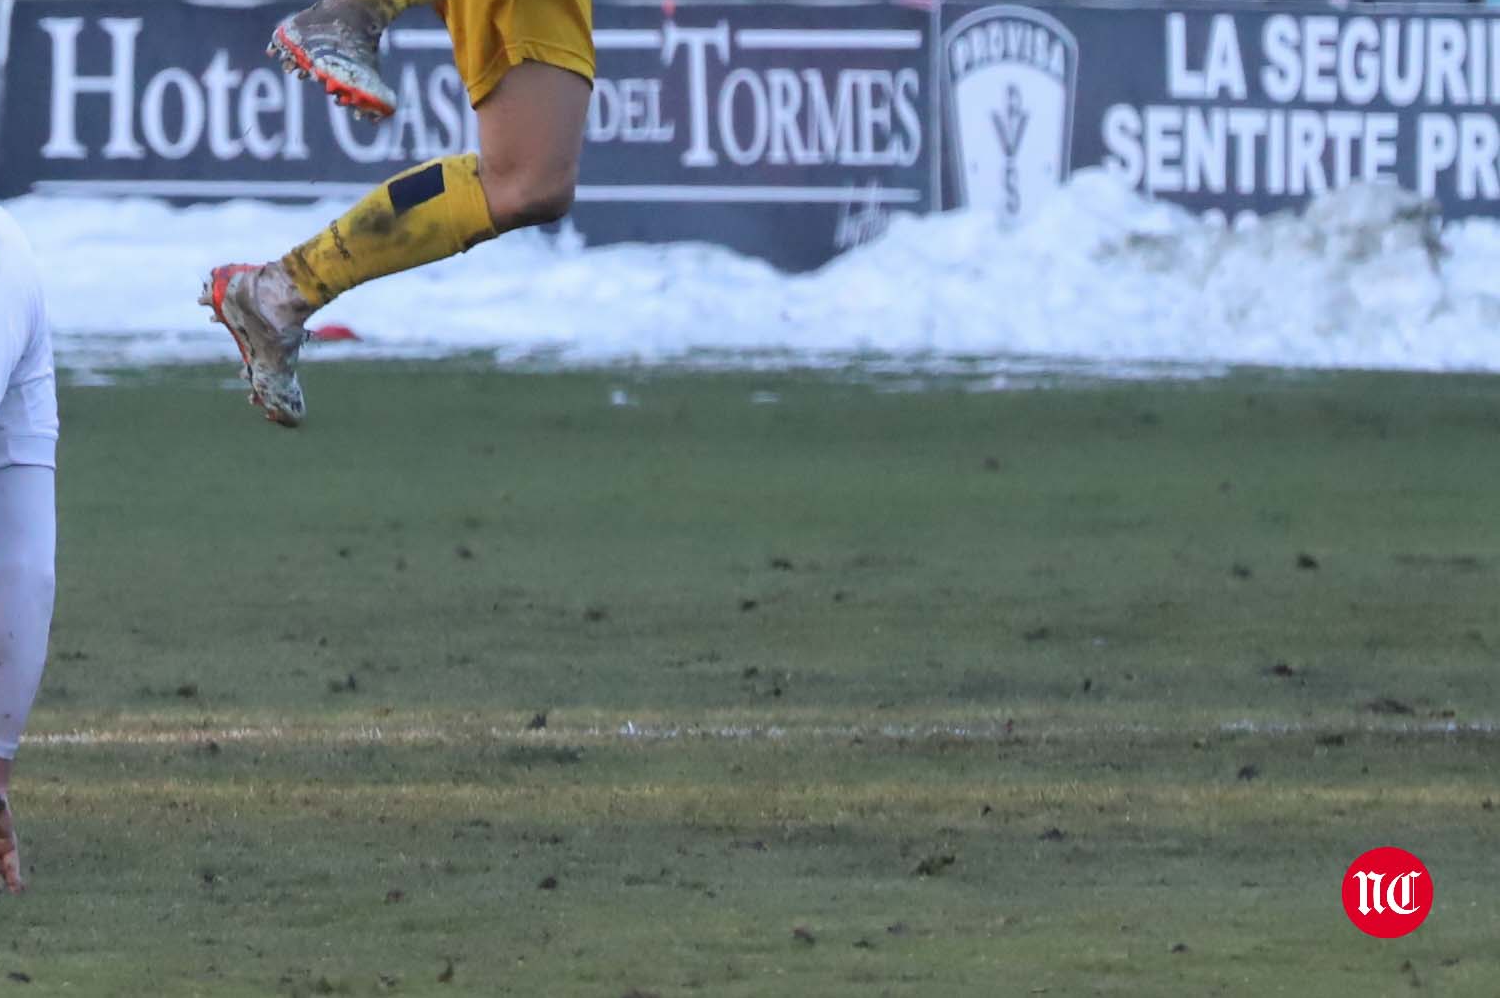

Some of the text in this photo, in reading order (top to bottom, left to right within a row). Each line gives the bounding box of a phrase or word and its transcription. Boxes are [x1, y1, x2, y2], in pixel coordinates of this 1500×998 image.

[38, 16, 310, 160] Hotel
[587, 77, 675, 143] DEL
[660, 19, 922, 168] TORMES
[1166, 11, 1248, 100] LA
[1102, 103, 1500, 200] SENTIRTE PR
